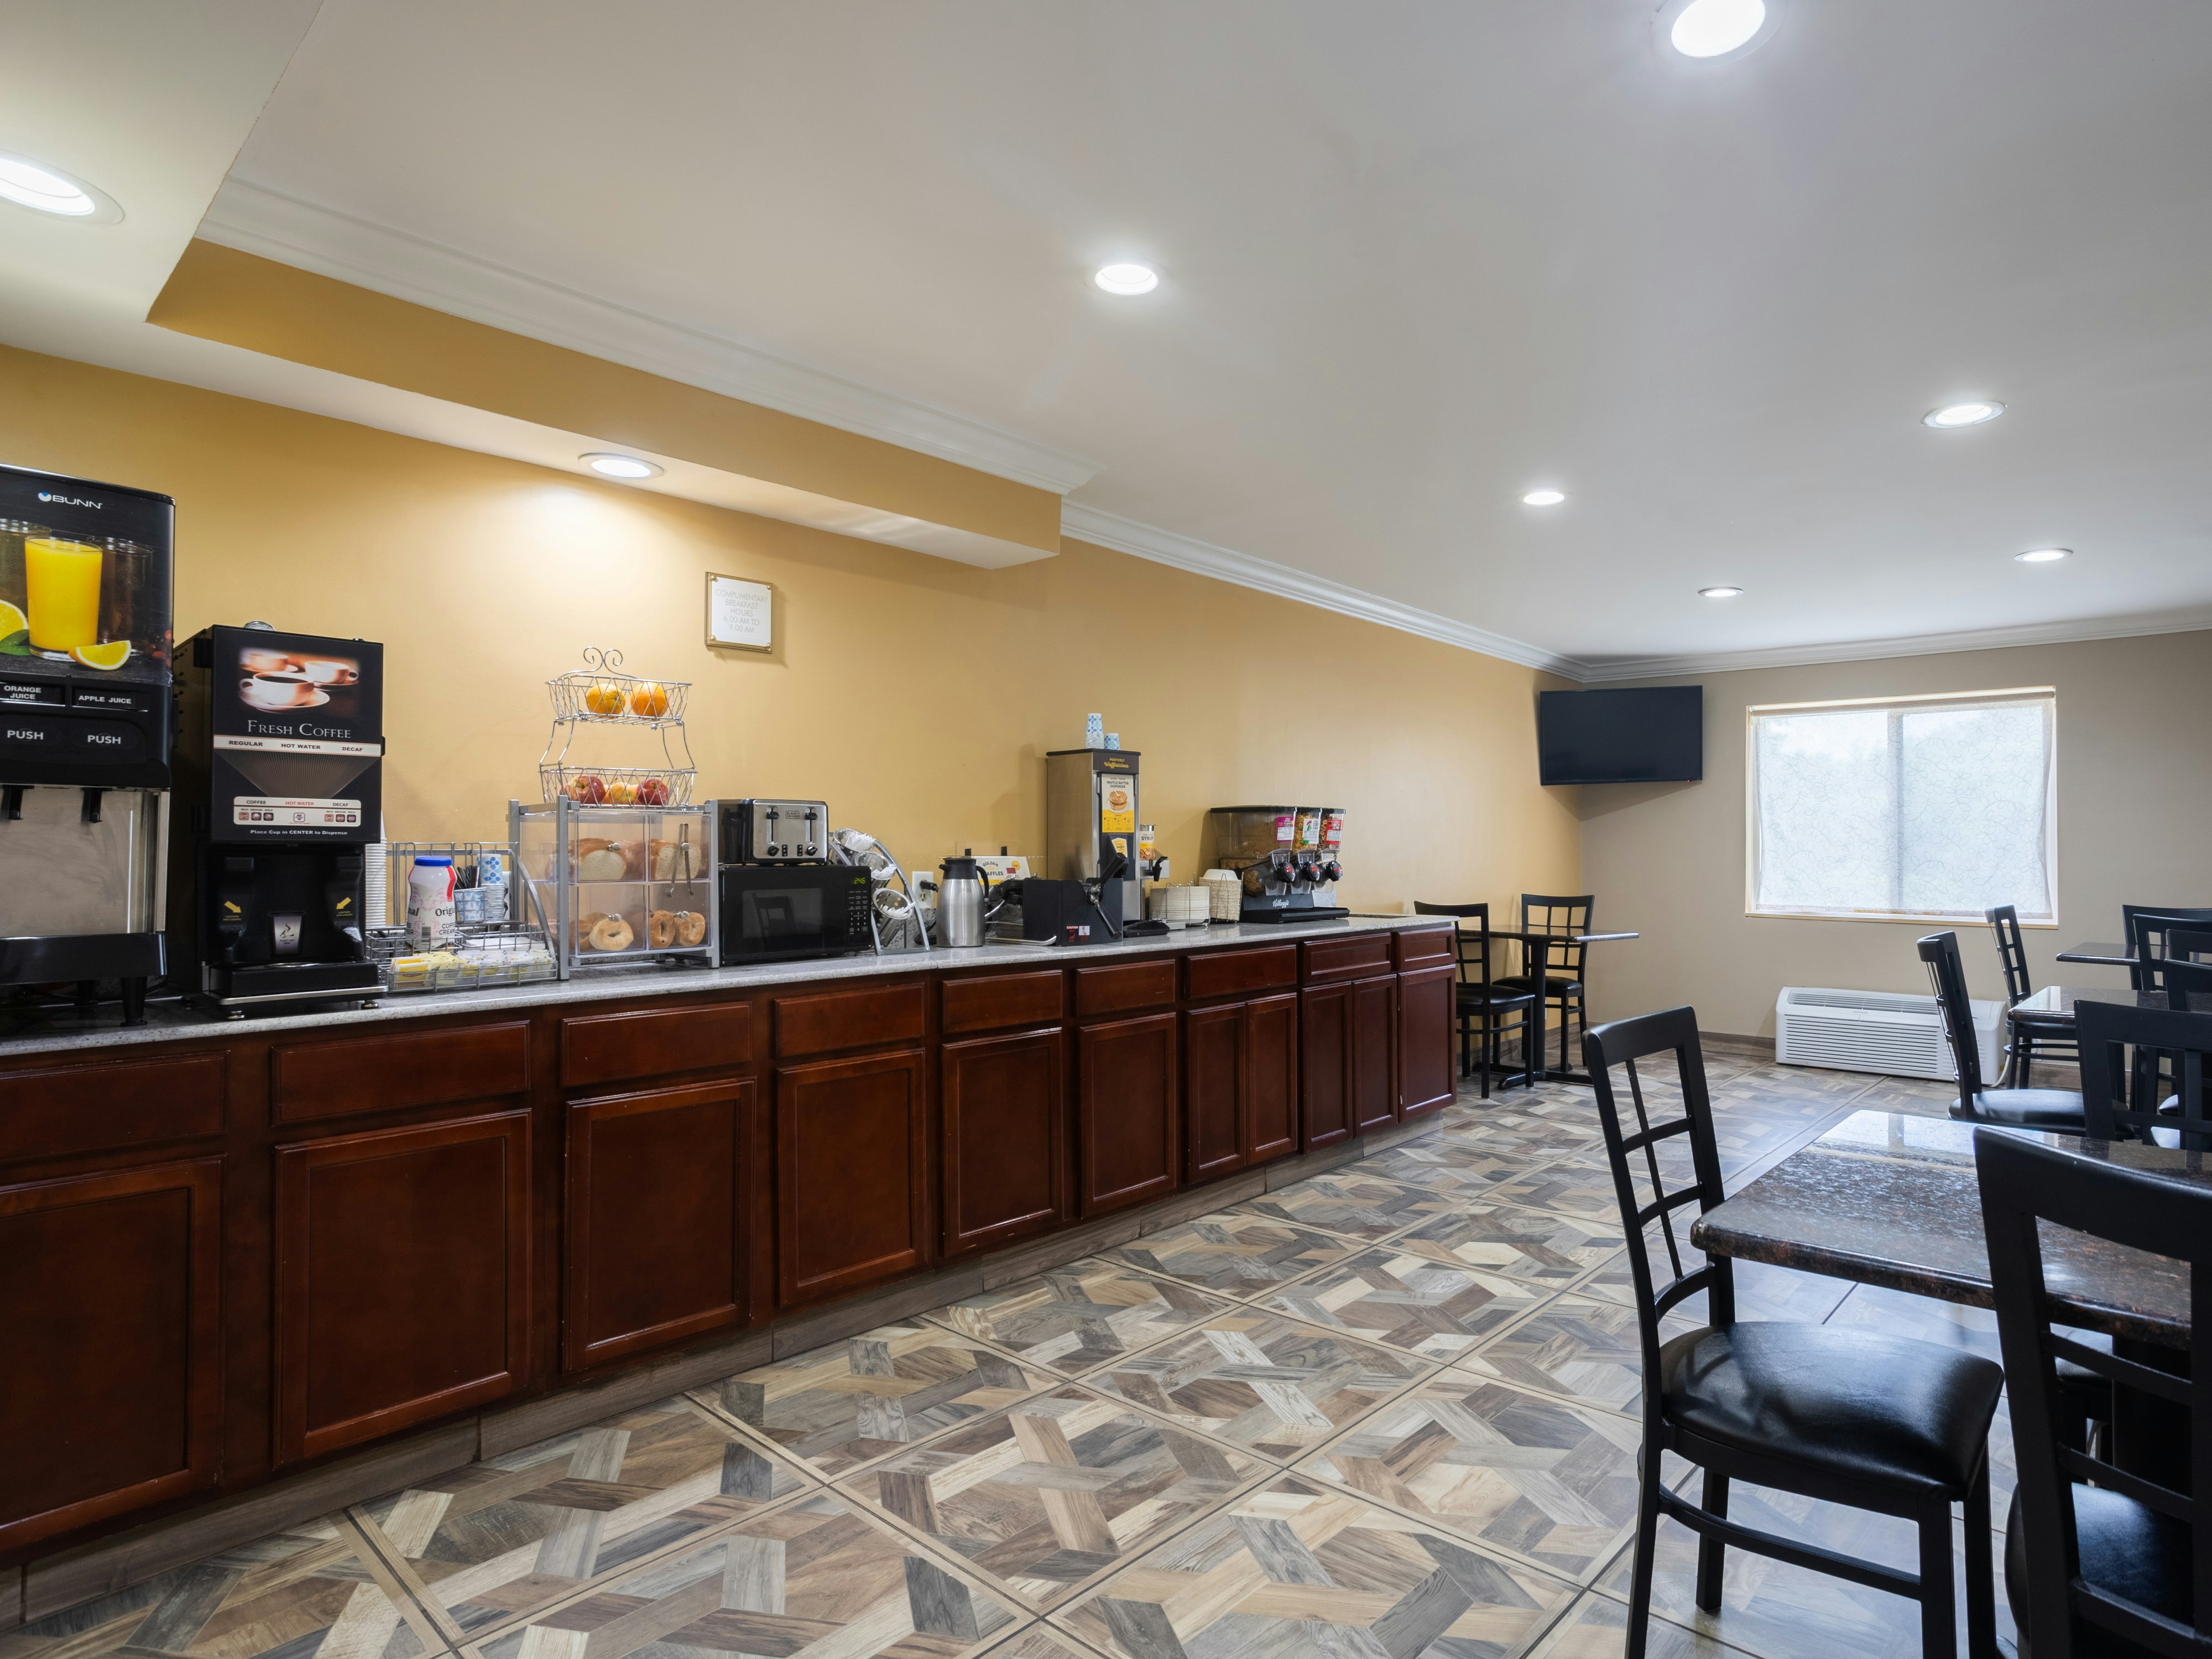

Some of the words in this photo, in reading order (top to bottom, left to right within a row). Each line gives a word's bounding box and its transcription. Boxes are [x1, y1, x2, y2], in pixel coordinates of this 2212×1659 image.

[52, 494, 102, 509] BUNN
[715, 588, 768, 603] COMPLIMENTARY
[725, 598, 758, 609] BREAKFAST
[731, 607, 753, 617] HOURS
[247, 719, 293, 734] FRESH
[299, 723, 351, 738] COFFEE
[7, 730, 44, 740] PUSH
[87, 734, 121, 744] PUSH
